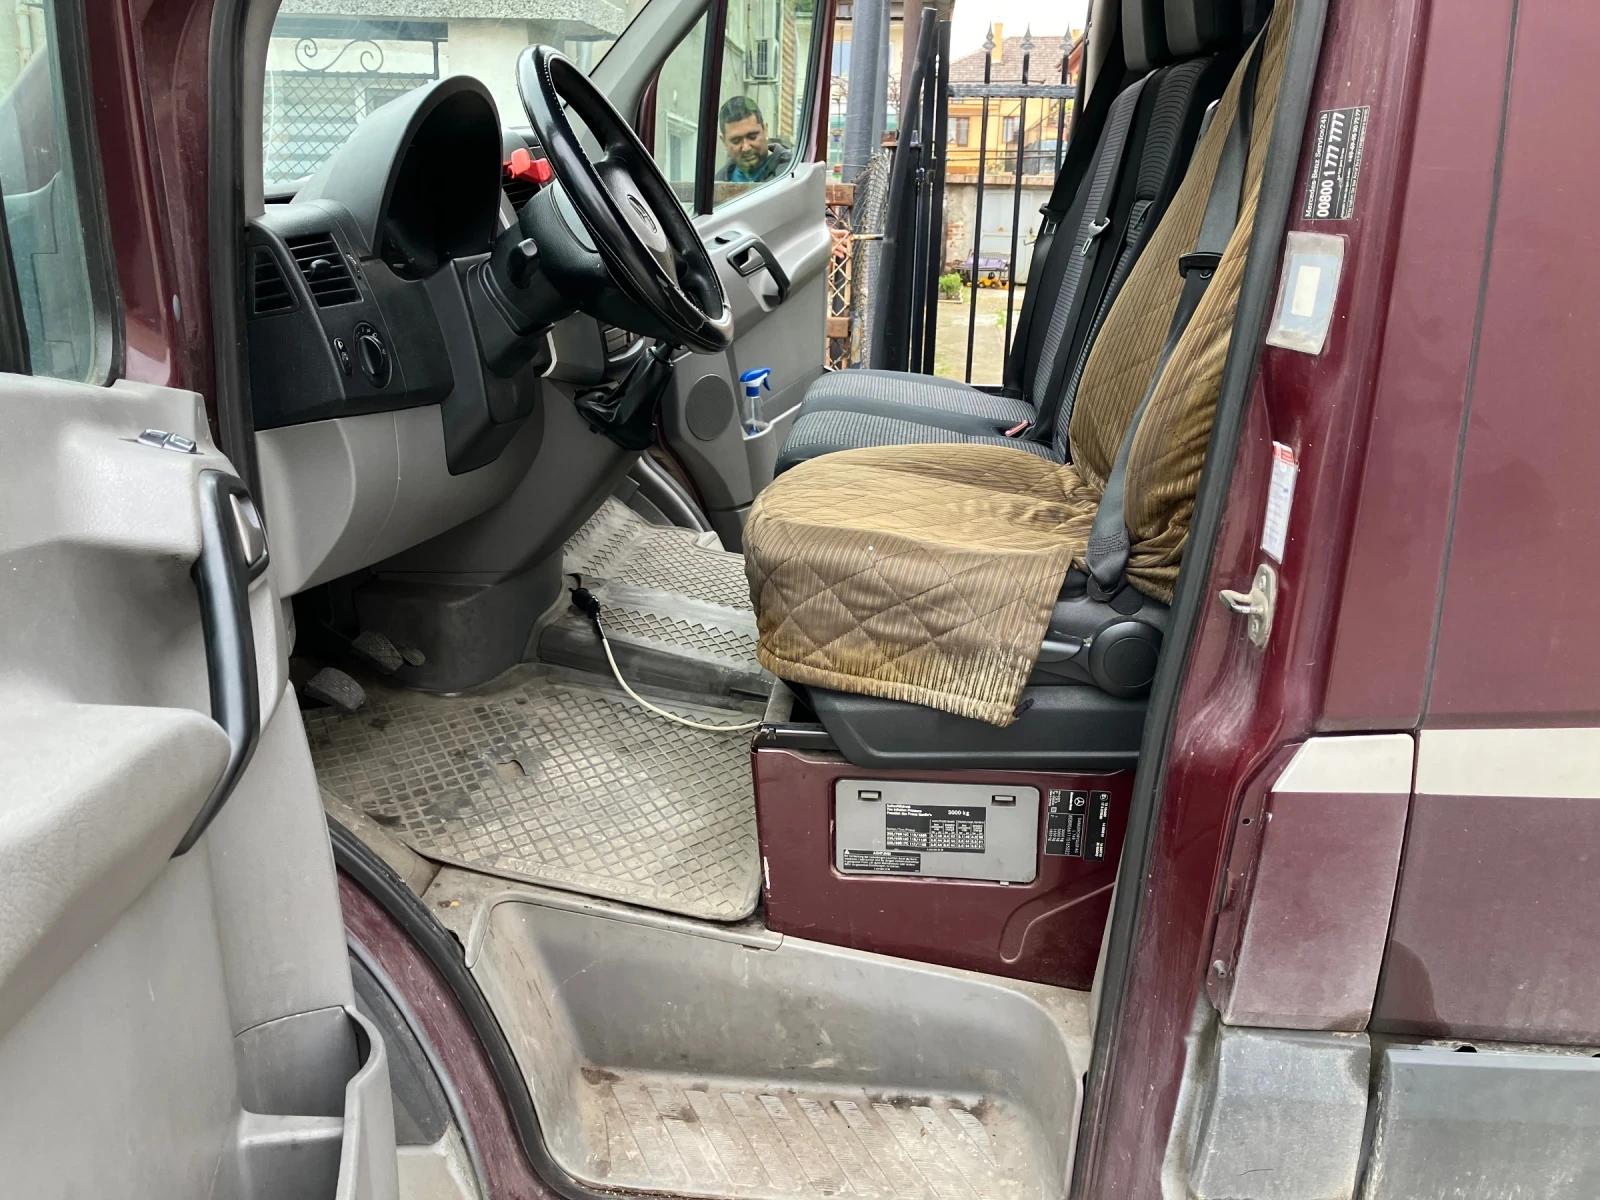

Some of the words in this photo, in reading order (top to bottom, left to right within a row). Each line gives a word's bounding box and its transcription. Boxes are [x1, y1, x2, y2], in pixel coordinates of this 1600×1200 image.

[1329, 112, 1345, 143] 7777
[1305, 158, 1320, 218] Mercedes-Benz
[1315, 113, 1328, 158] Service24h
[1324, 144, 1339, 168] 777
[1316, 179, 1334, 218] 00800
[962, 809, 970, 817] kg
